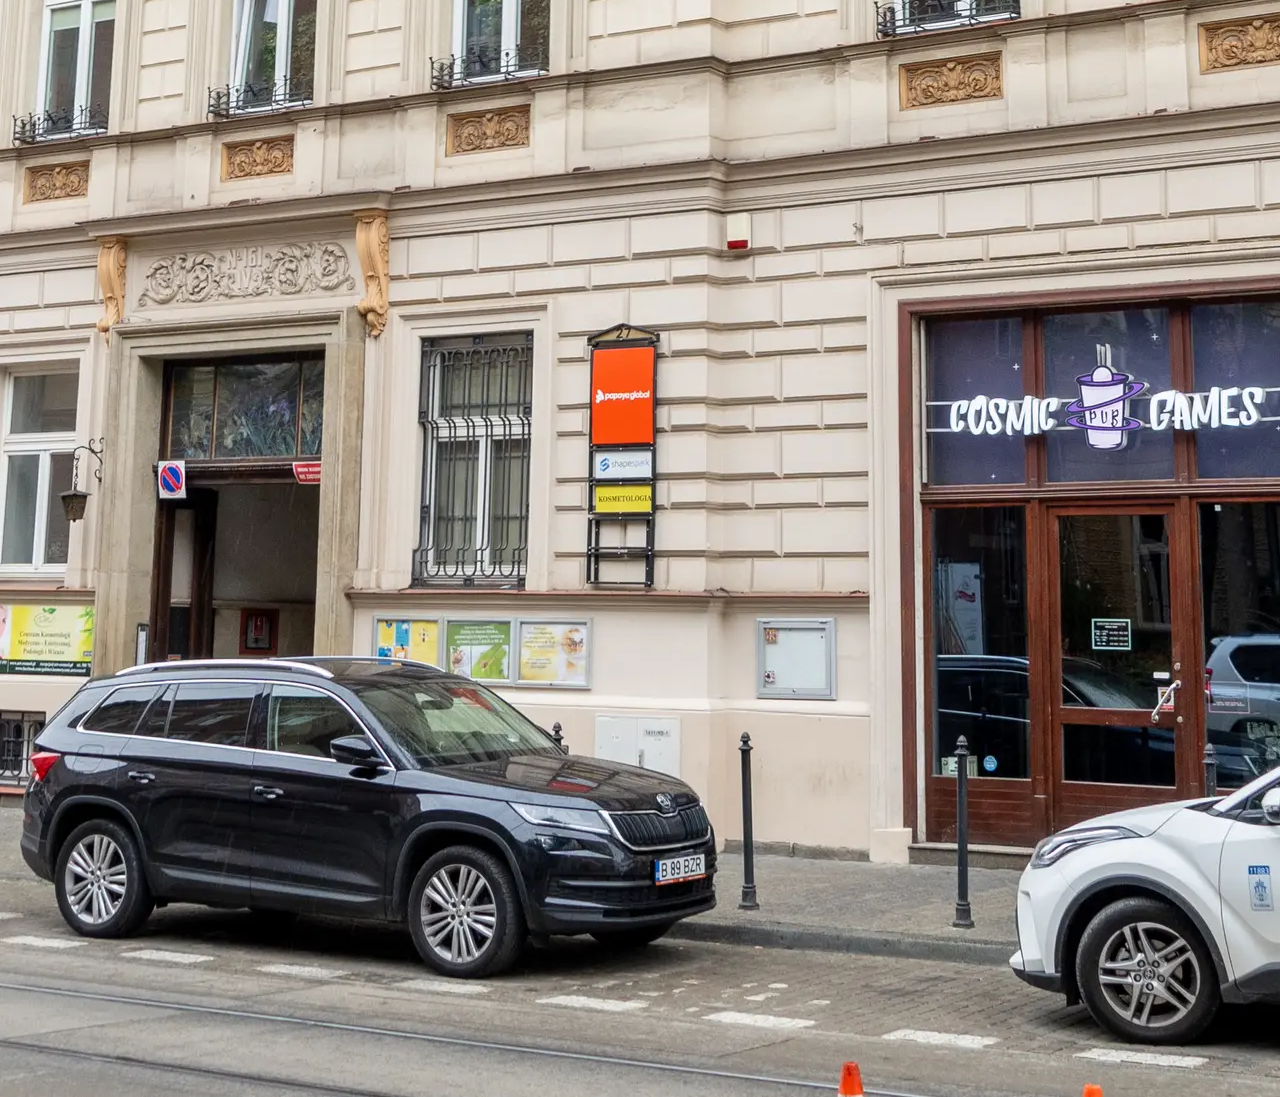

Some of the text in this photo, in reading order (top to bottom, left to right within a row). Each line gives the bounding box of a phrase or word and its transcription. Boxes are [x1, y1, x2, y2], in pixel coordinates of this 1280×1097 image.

[615, 327, 632, 340] 27
[949, 386, 1267, 436] COSMIC GAMES
[1089, 408, 1119, 428] PUB
[610, 458, 651, 470] shapespark
[598, 494, 652, 504] KOSMETOLOGIA
[661, 857, 702, 878] B 89 BZR
